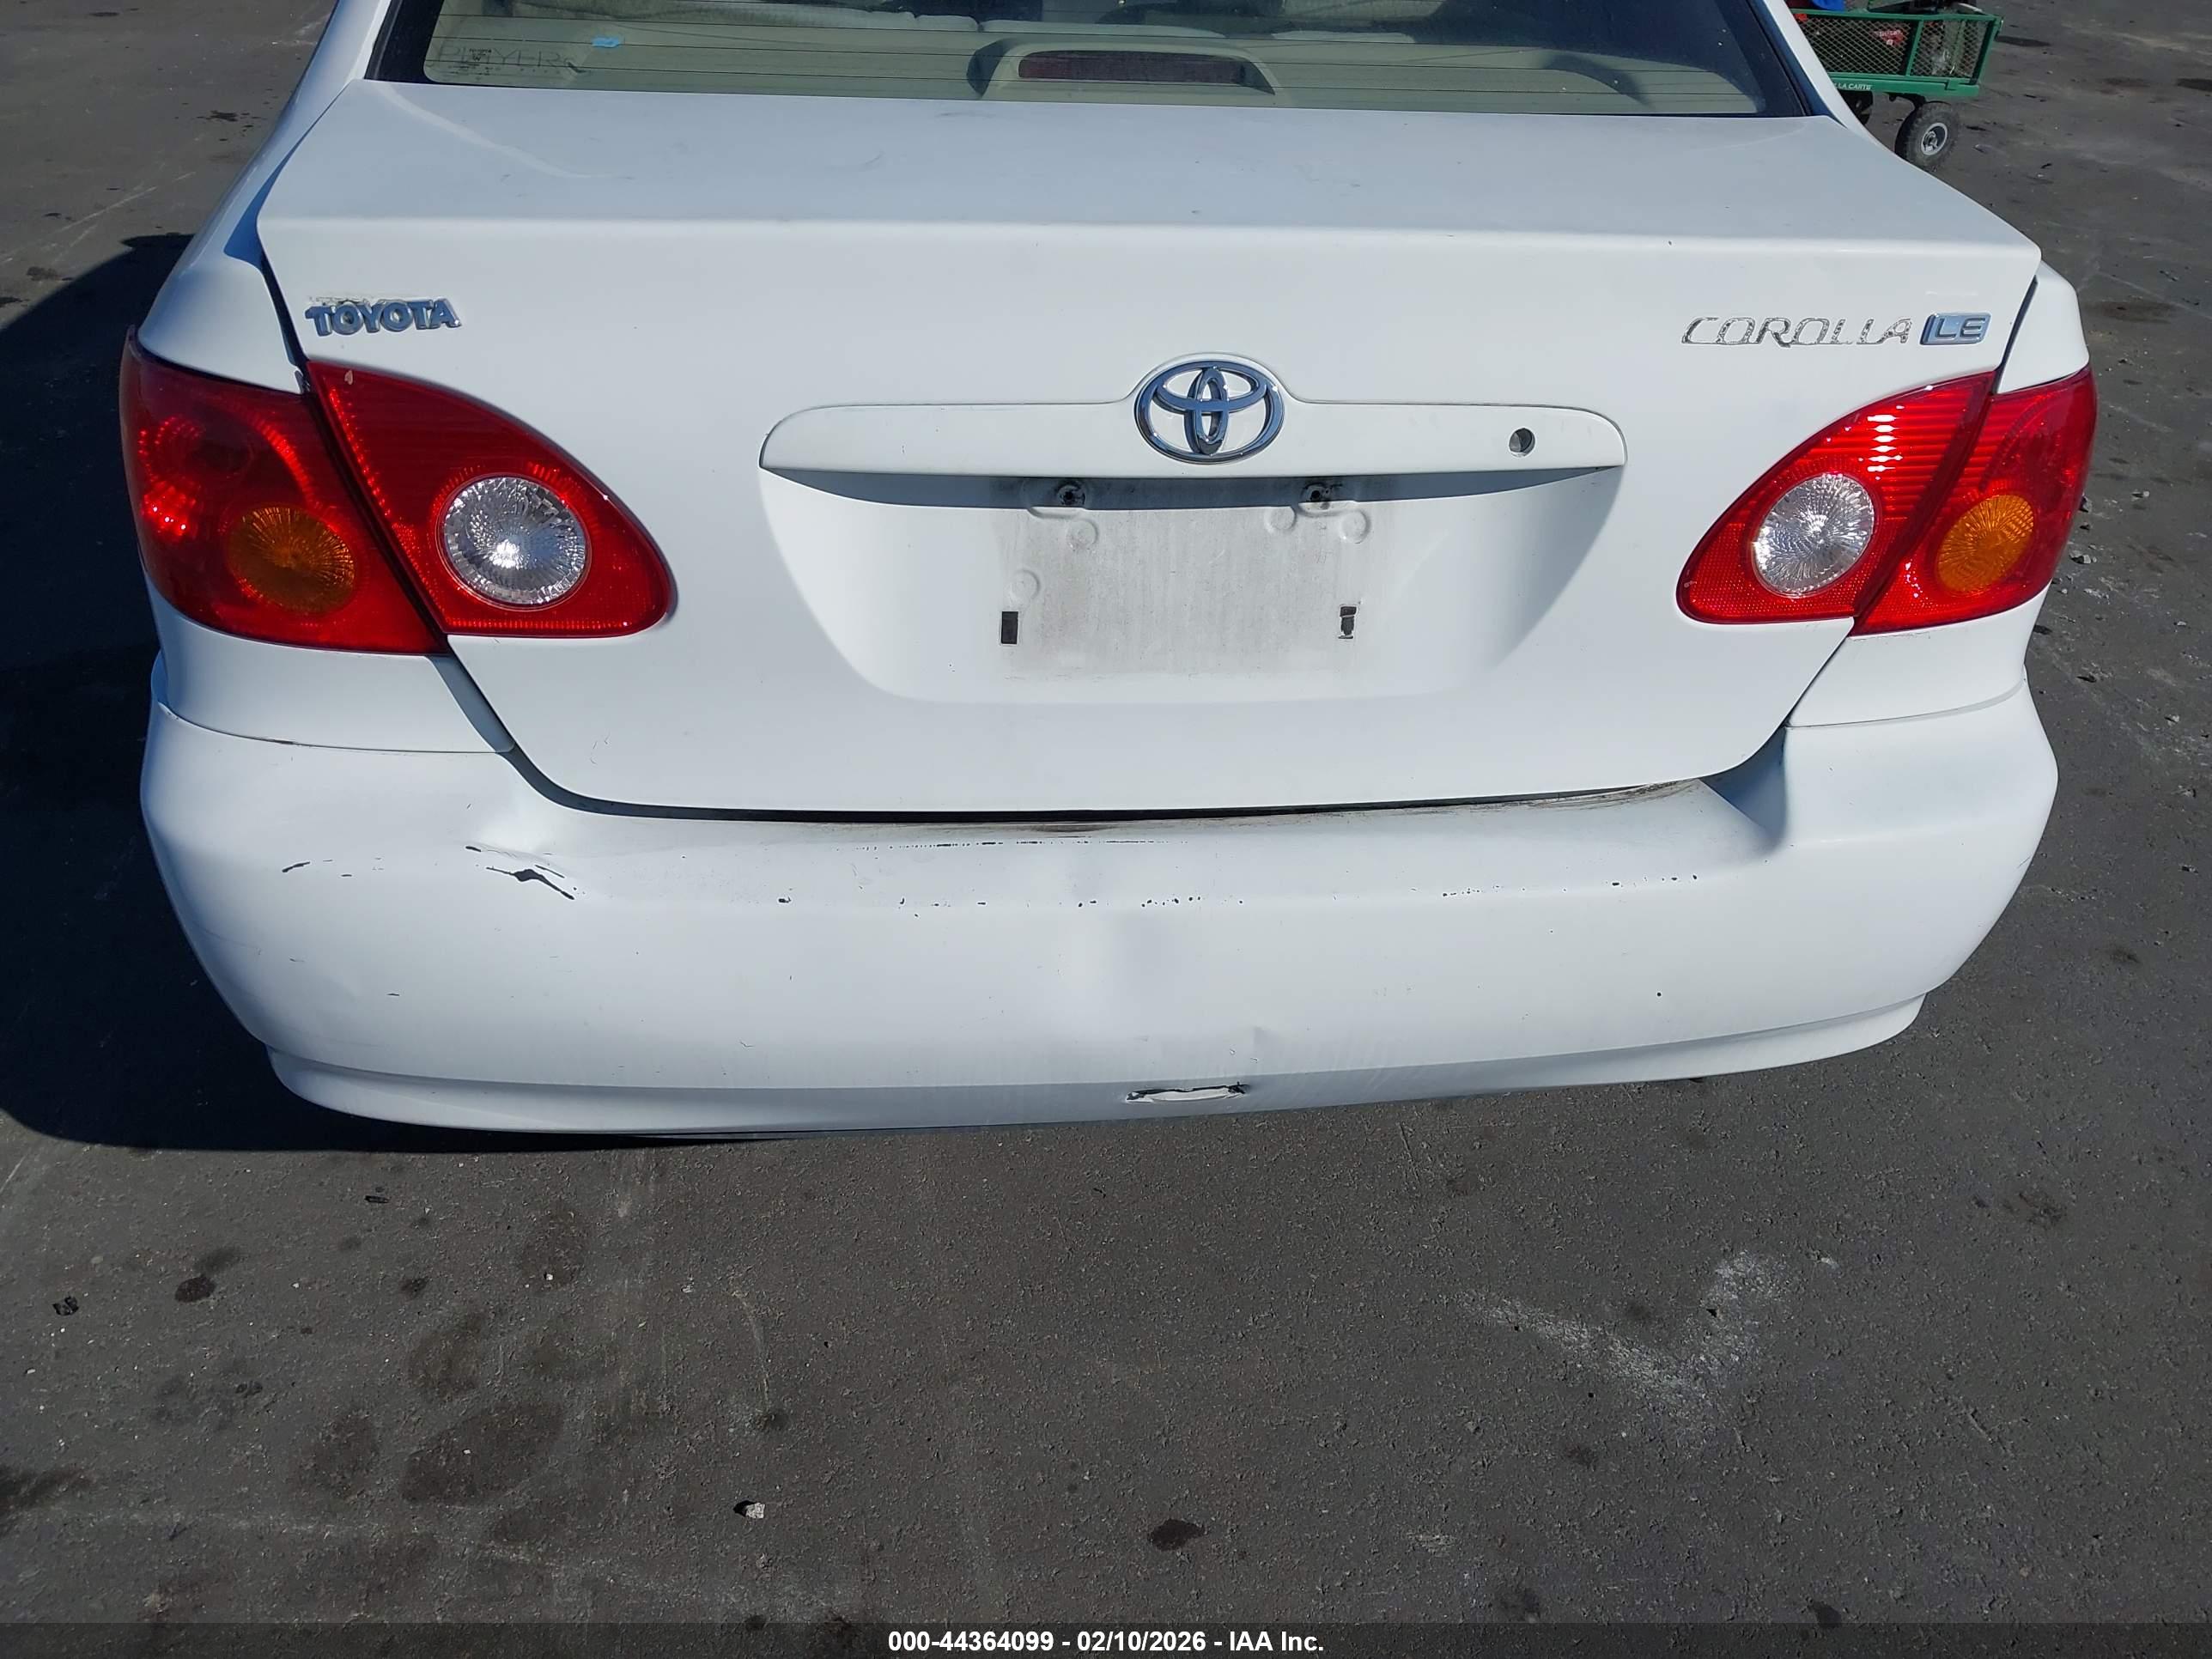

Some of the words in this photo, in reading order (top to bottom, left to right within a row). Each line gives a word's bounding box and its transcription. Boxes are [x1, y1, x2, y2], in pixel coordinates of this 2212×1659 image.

[305, 299, 462, 336] TOYOTA
[1681, 317, 1912, 348] COROLLA
[1931, 314, 1990, 341] LE
